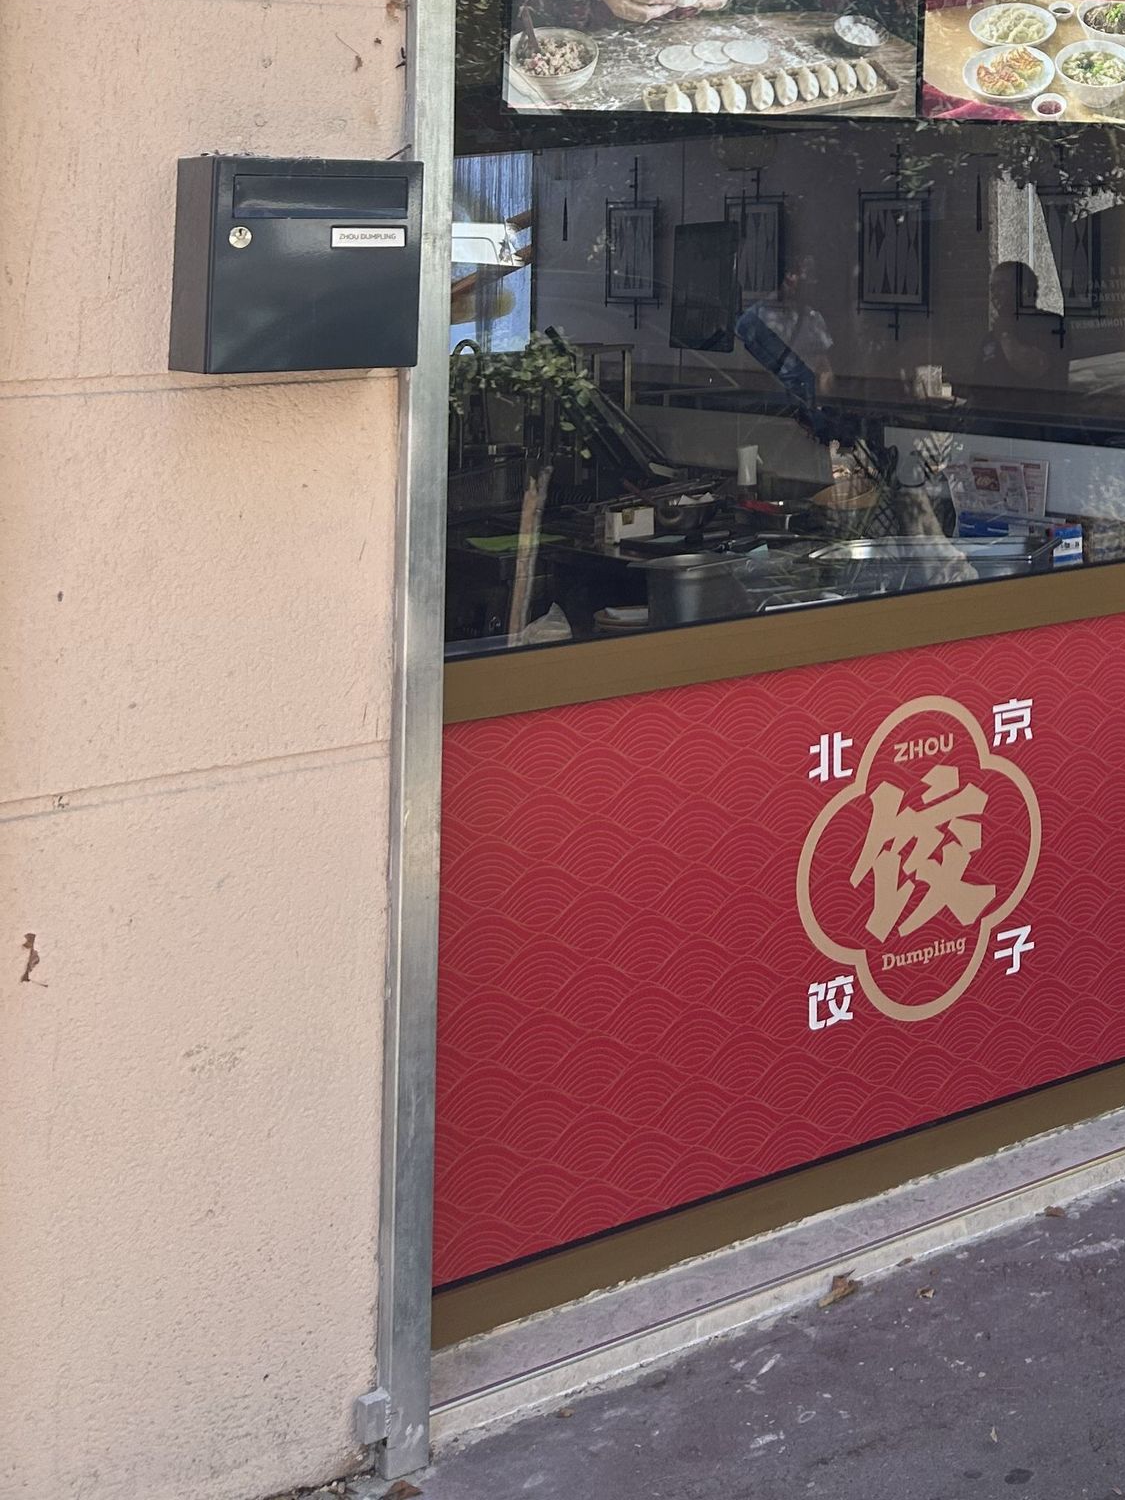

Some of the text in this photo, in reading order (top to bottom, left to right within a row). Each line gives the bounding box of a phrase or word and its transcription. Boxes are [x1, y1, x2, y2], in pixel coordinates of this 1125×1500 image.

[339, 233, 359, 241] ZHOU
[808, 698, 1034, 783] 北 京
[893, 732, 954, 763] ZHOU
[849, 763, 997, 943] 饺
[807, 924, 1035, 1031] 饺 子
[881, 936, 967, 971] Dumpling
